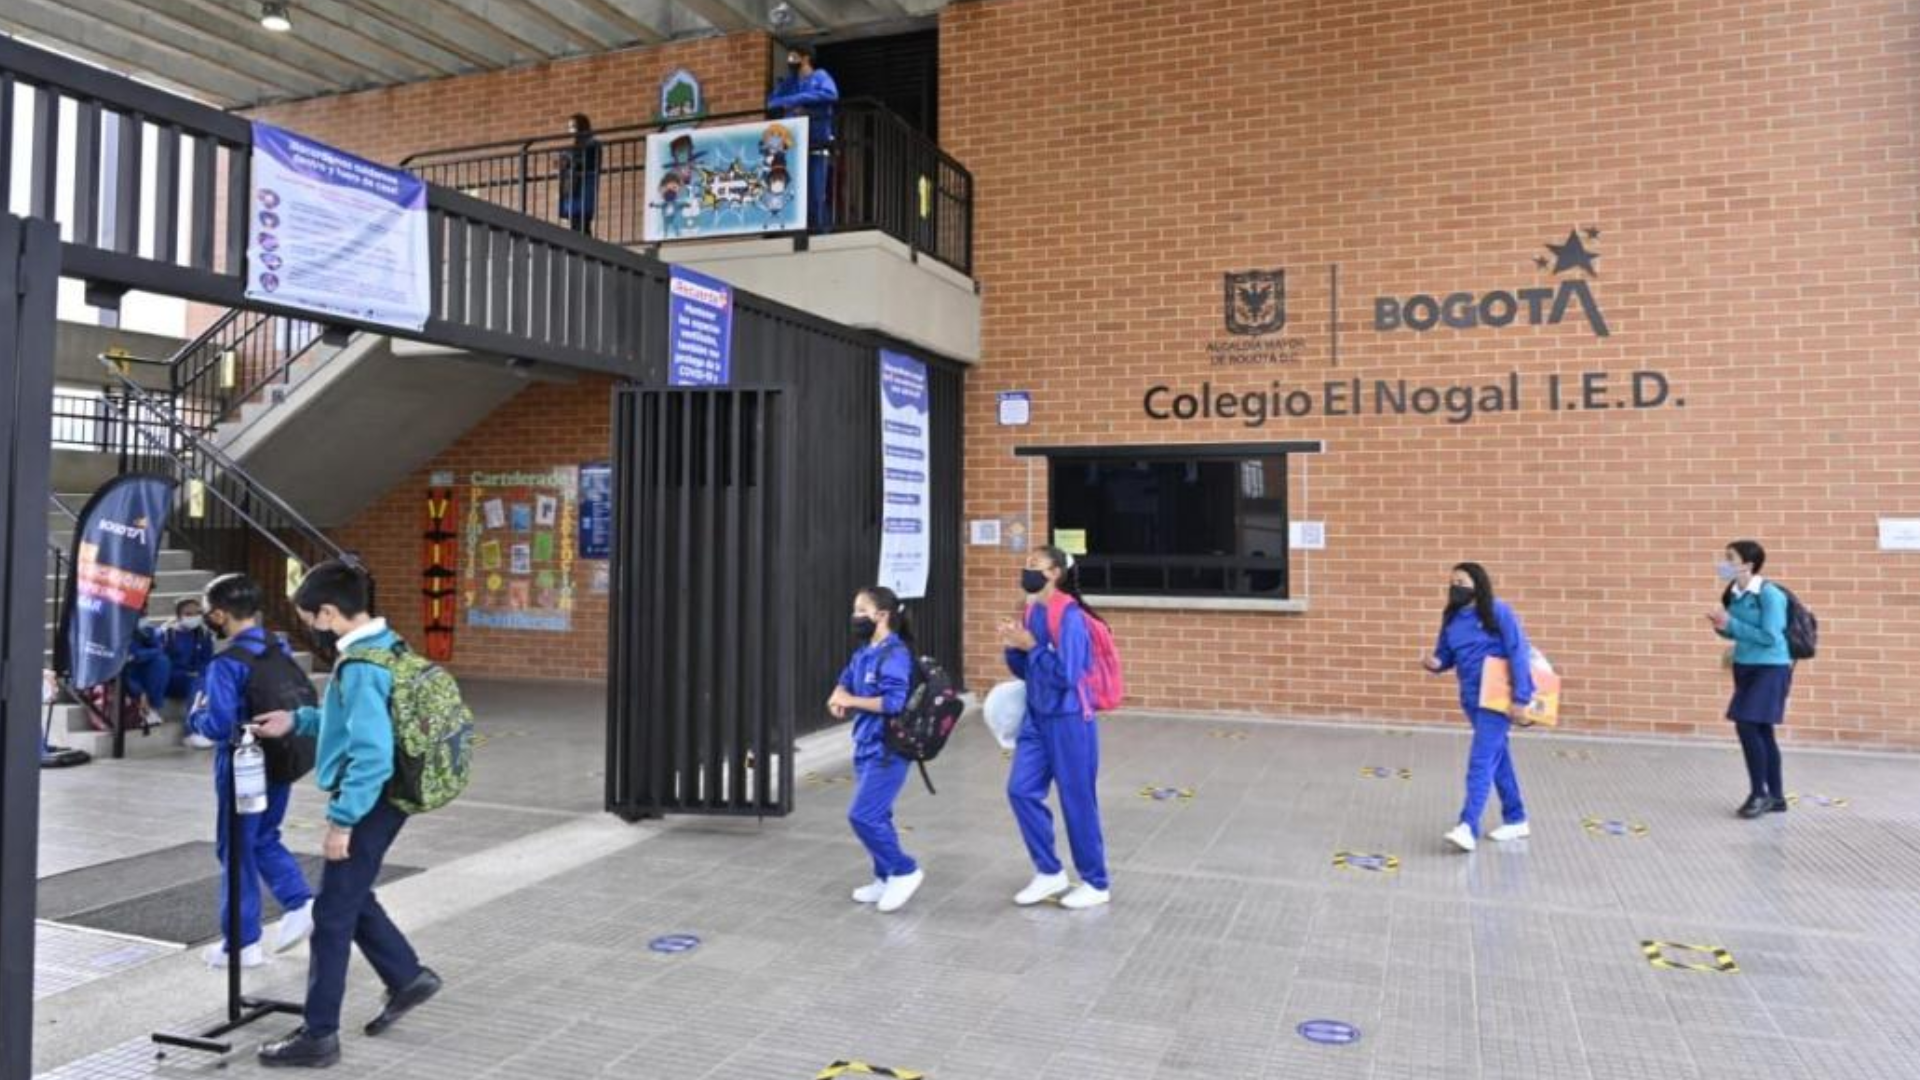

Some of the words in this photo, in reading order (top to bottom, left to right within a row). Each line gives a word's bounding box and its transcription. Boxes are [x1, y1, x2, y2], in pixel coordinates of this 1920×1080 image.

[1143, 380, 1312, 427] Colegio
[1323, 378, 1361, 415] El
[1374, 371, 1519, 425] Nogal
[1549, 371, 1685, 411] I.E.D.
